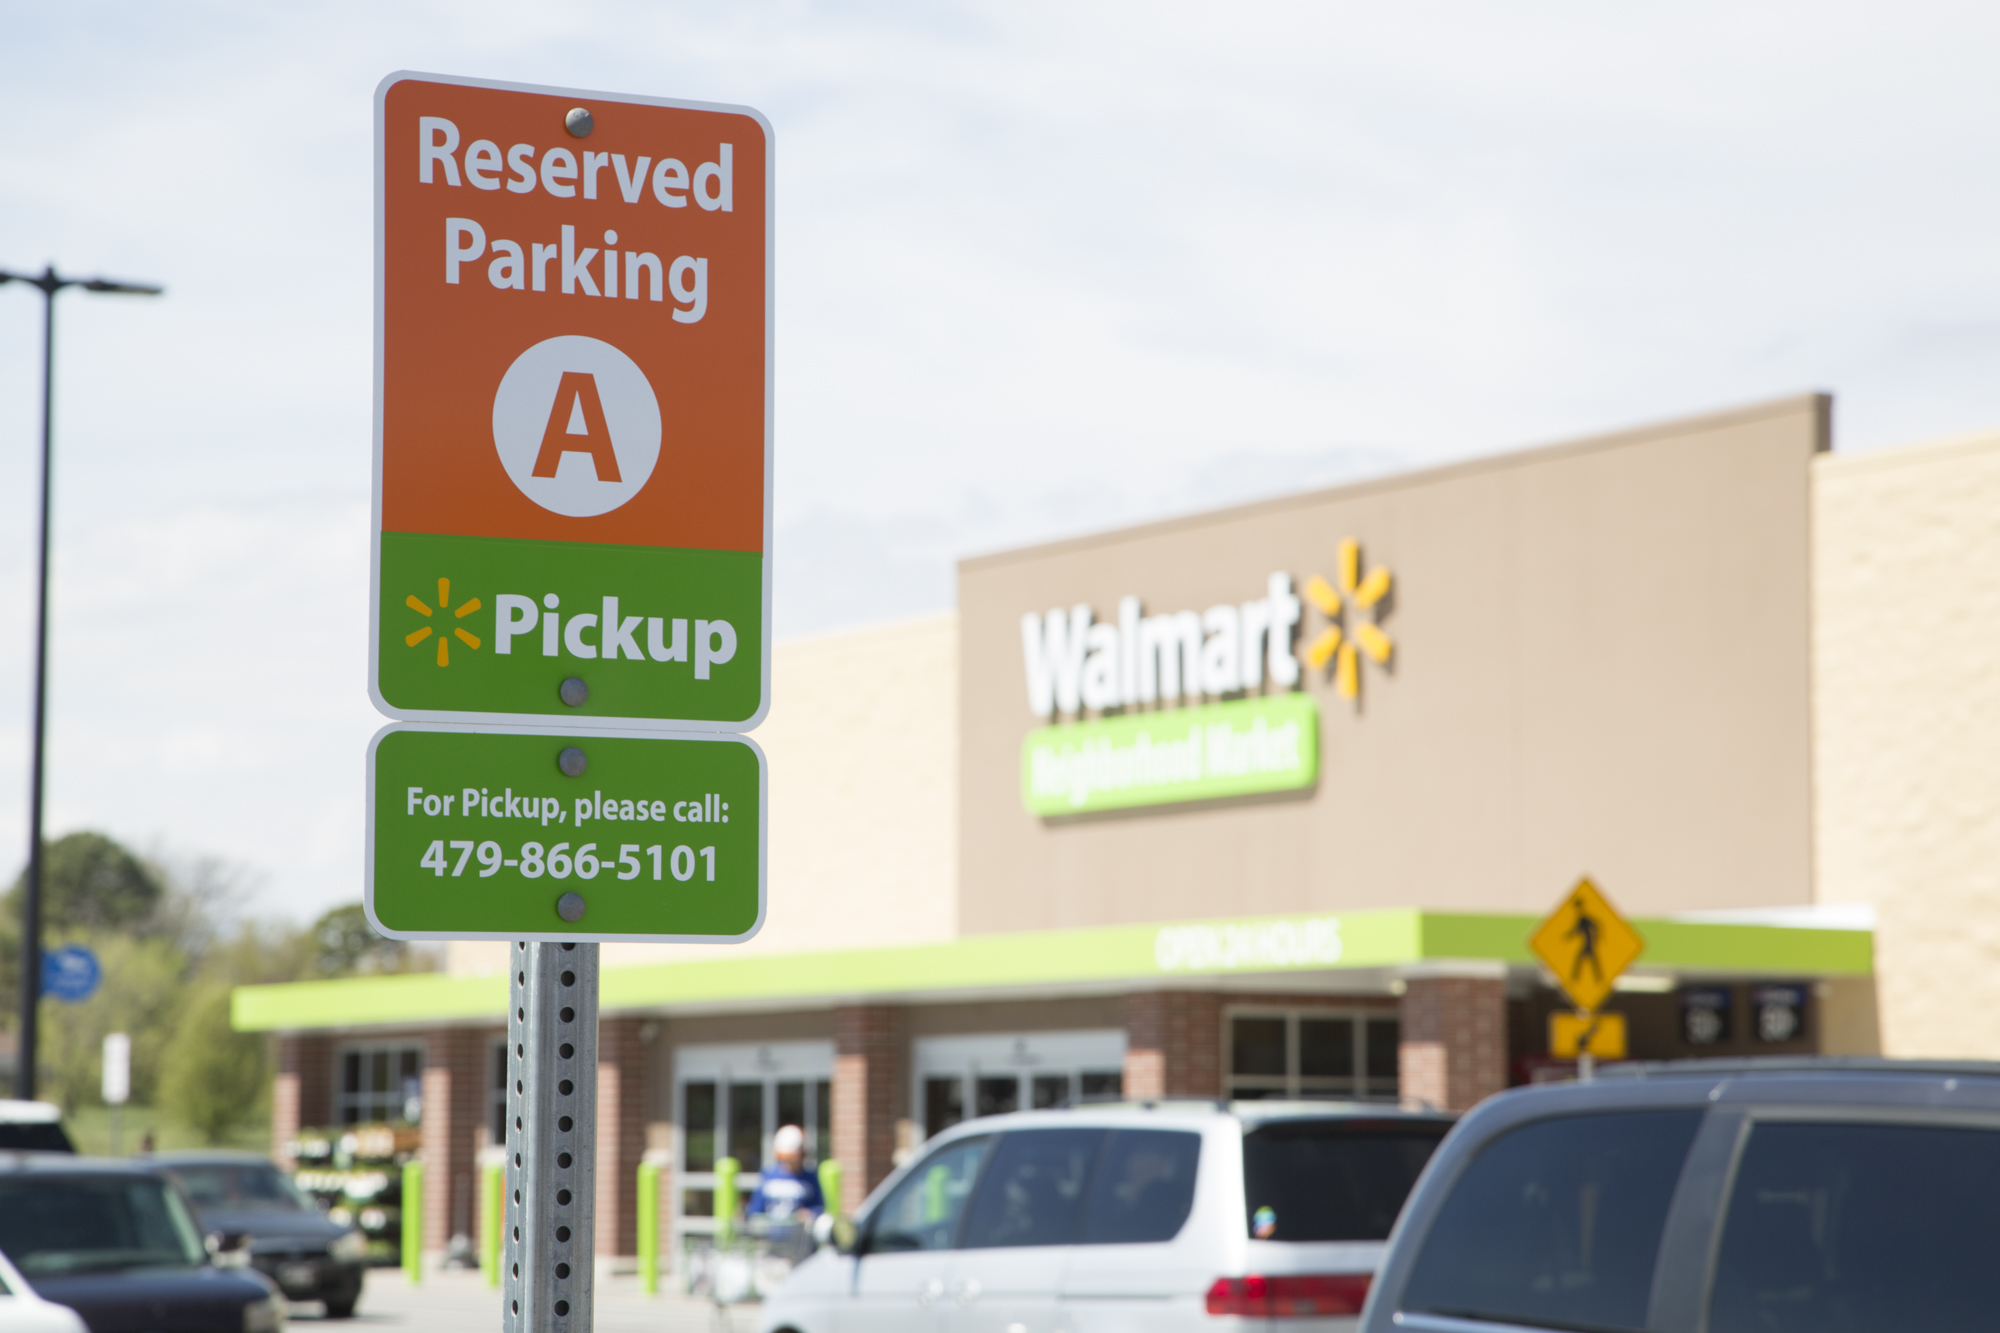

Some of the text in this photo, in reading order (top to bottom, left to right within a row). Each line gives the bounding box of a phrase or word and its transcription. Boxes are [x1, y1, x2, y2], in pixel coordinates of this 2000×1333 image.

[419, 116, 733, 212] Reserved
[445, 217, 708, 324] Parking
[531, 371, 623, 483] A
[495, 593, 738, 681] Pickup
[1020, 570, 1300, 717] Walmart
[1205, 715, 1301, 778] Market
[407, 787, 729, 827] For Pickup, please call:
[420, 840, 716, 882] 479-866-5101
